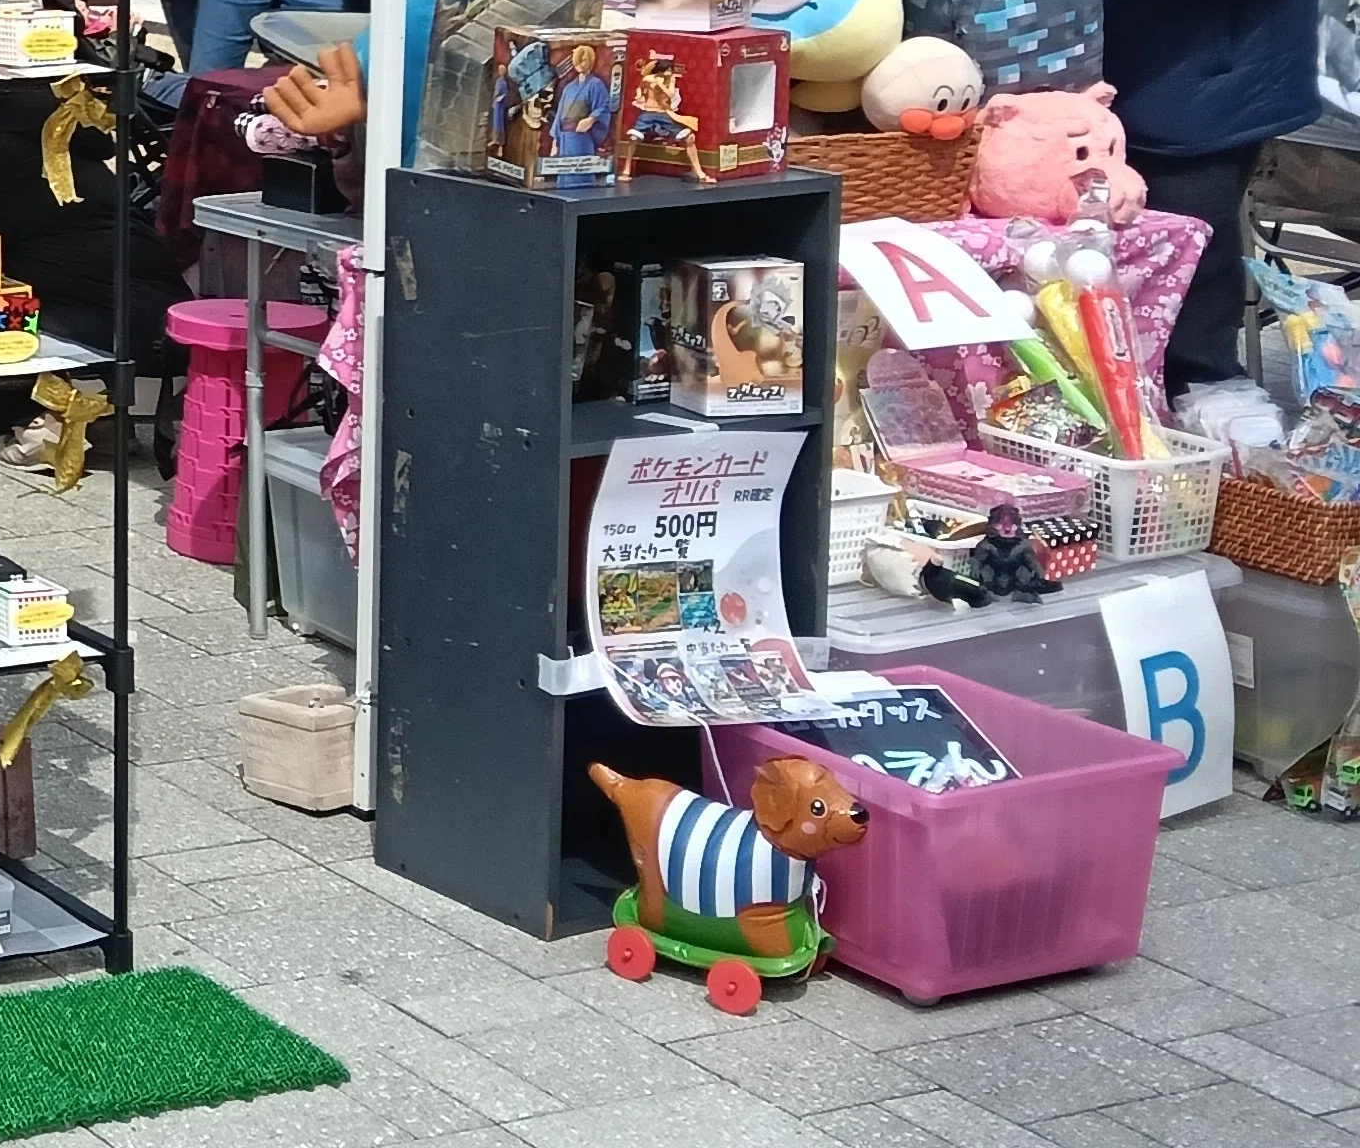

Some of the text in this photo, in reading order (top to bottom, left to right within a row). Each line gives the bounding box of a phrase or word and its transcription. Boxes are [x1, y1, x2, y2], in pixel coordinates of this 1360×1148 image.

[873, 240, 991, 324] A
[631, 451, 768, 480] ポケモンカード
[661, 479, 721, 504] オリパ
[653, 511, 718, 539] 500円
[602, 539, 691, 562] 大当たり一覧
[1139, 649, 1206, 786] B
